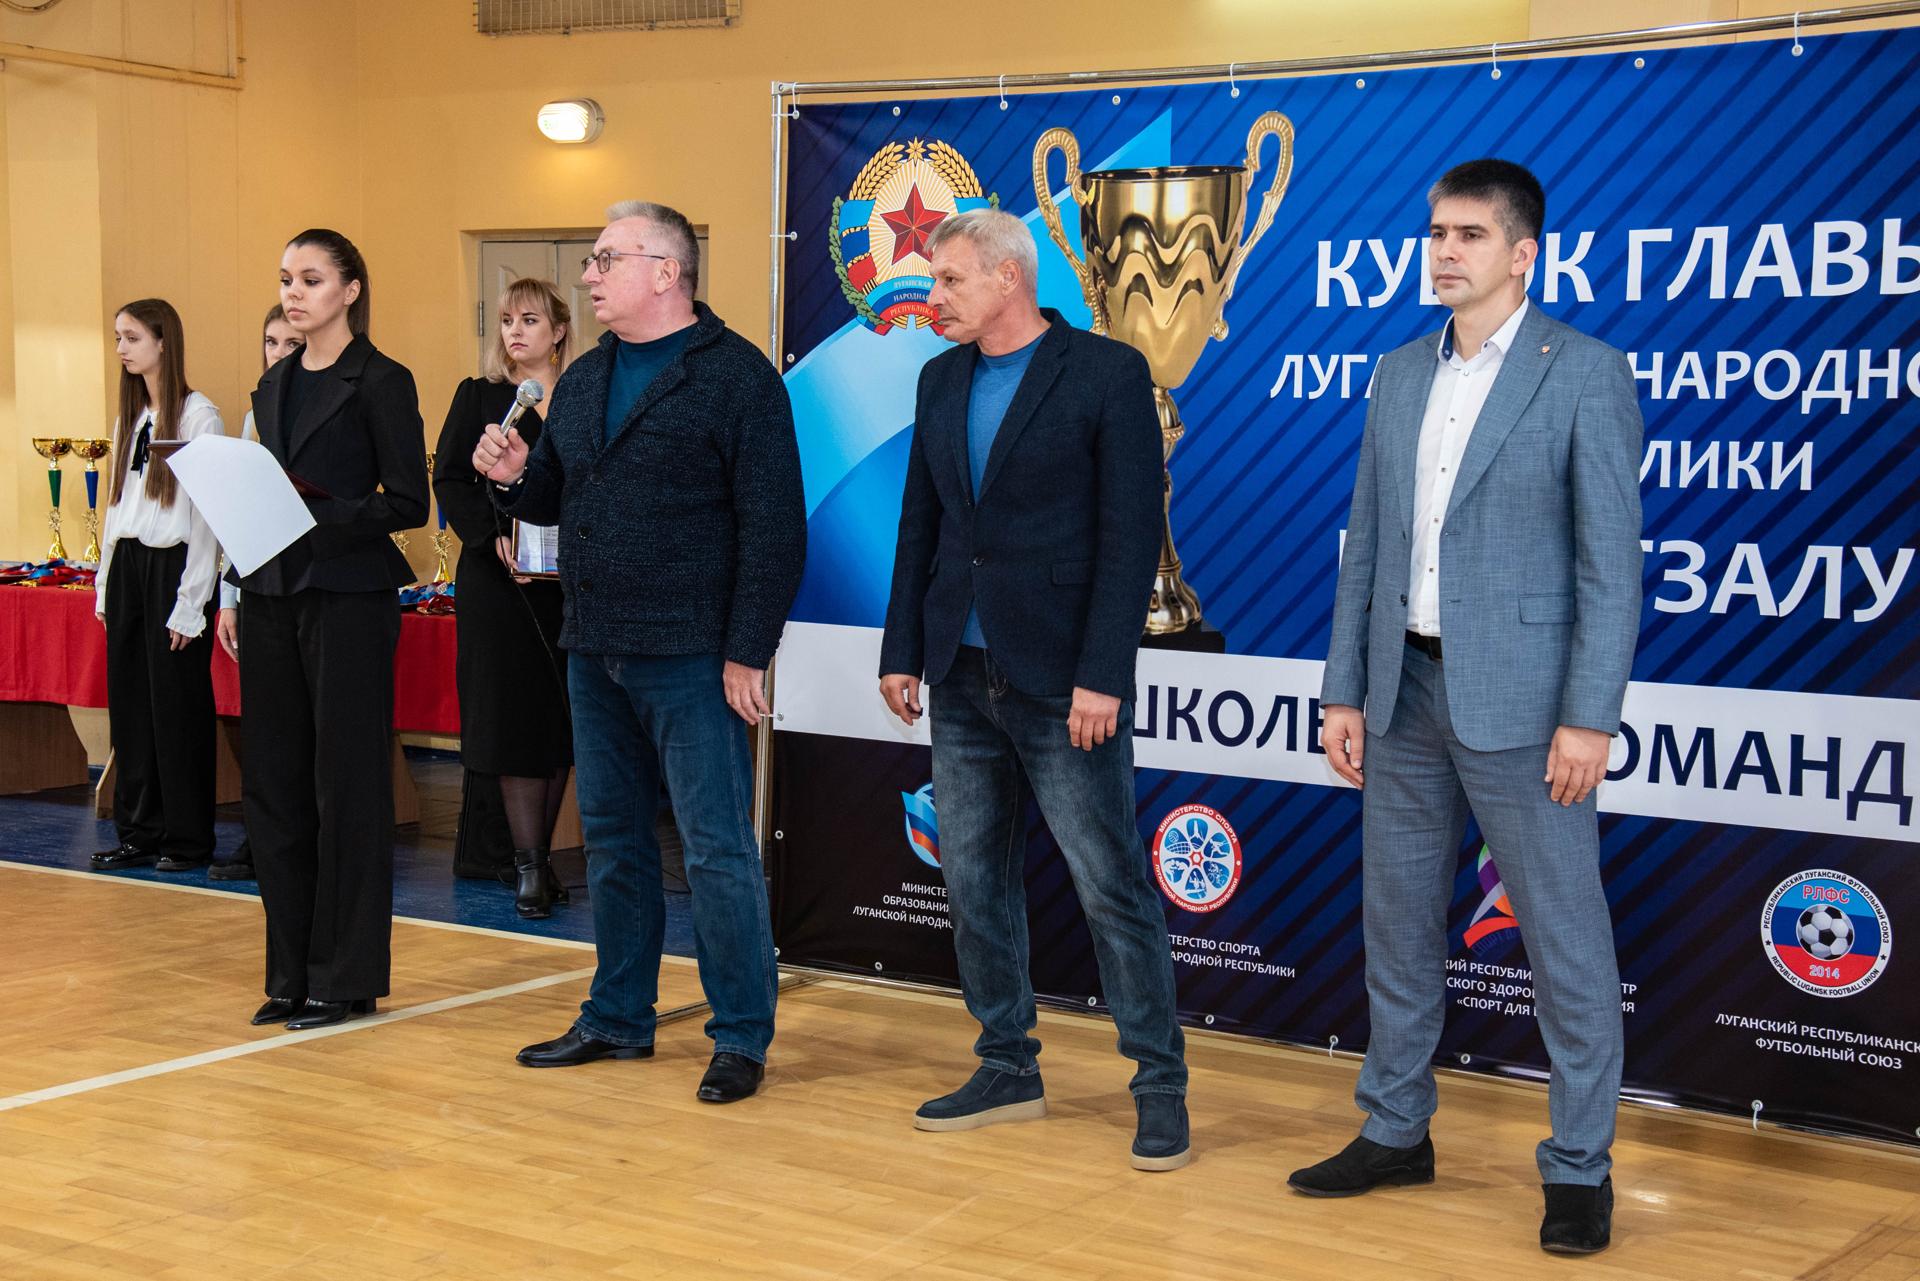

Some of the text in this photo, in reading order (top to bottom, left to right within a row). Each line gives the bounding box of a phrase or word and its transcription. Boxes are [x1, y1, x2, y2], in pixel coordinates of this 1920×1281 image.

[1316, 231, 1595, 308] КУК
[1627, 349, 1920, 415] НАРОДН
[1639, 440, 1814, 491] ЛИКИ
[1639, 540, 1916, 623] ЗАЛУ
[1604, 721, 1914, 827] ОМАНД
[1159, 805, 1238, 844] МИНИСТЕРСТВО СПОРТА
[901, 882, 947, 897] МИНИСТЕ
[1802, 884, 1850, 904] РЛФС
[853, 905, 907, 922] ЛУГАНСКОЙ
[1763, 871, 1890, 944] РЕСПУБЛИКАНСКИЙ ЛУГАНСКИЙ ФУТБОЛЬНЫЙ СОЮЗ
[1168, 934, 1261, 957] ТЕРСТВО СПОРТА
[1170, 951, 1296, 978] АРОДНОЙ РЕСПУБЛИКИ
[1469, 962, 1532, 981] РЕСПУБЛИ
[1771, 955, 1880, 996] REPUBLIC LUGANSK FOOTBALL UNION
[1809, 964, 1840, 979] 2014
[1446, 977, 1486, 992] СКОГО
[1504, 1002, 1530, 1016] ДЛЯ
[1715, 1013, 1797, 1035] ЛУГАНСКИЙ
[1755, 1037, 1902, 1069] ФУТБОЛЬНЫЙ СОЮЗ
